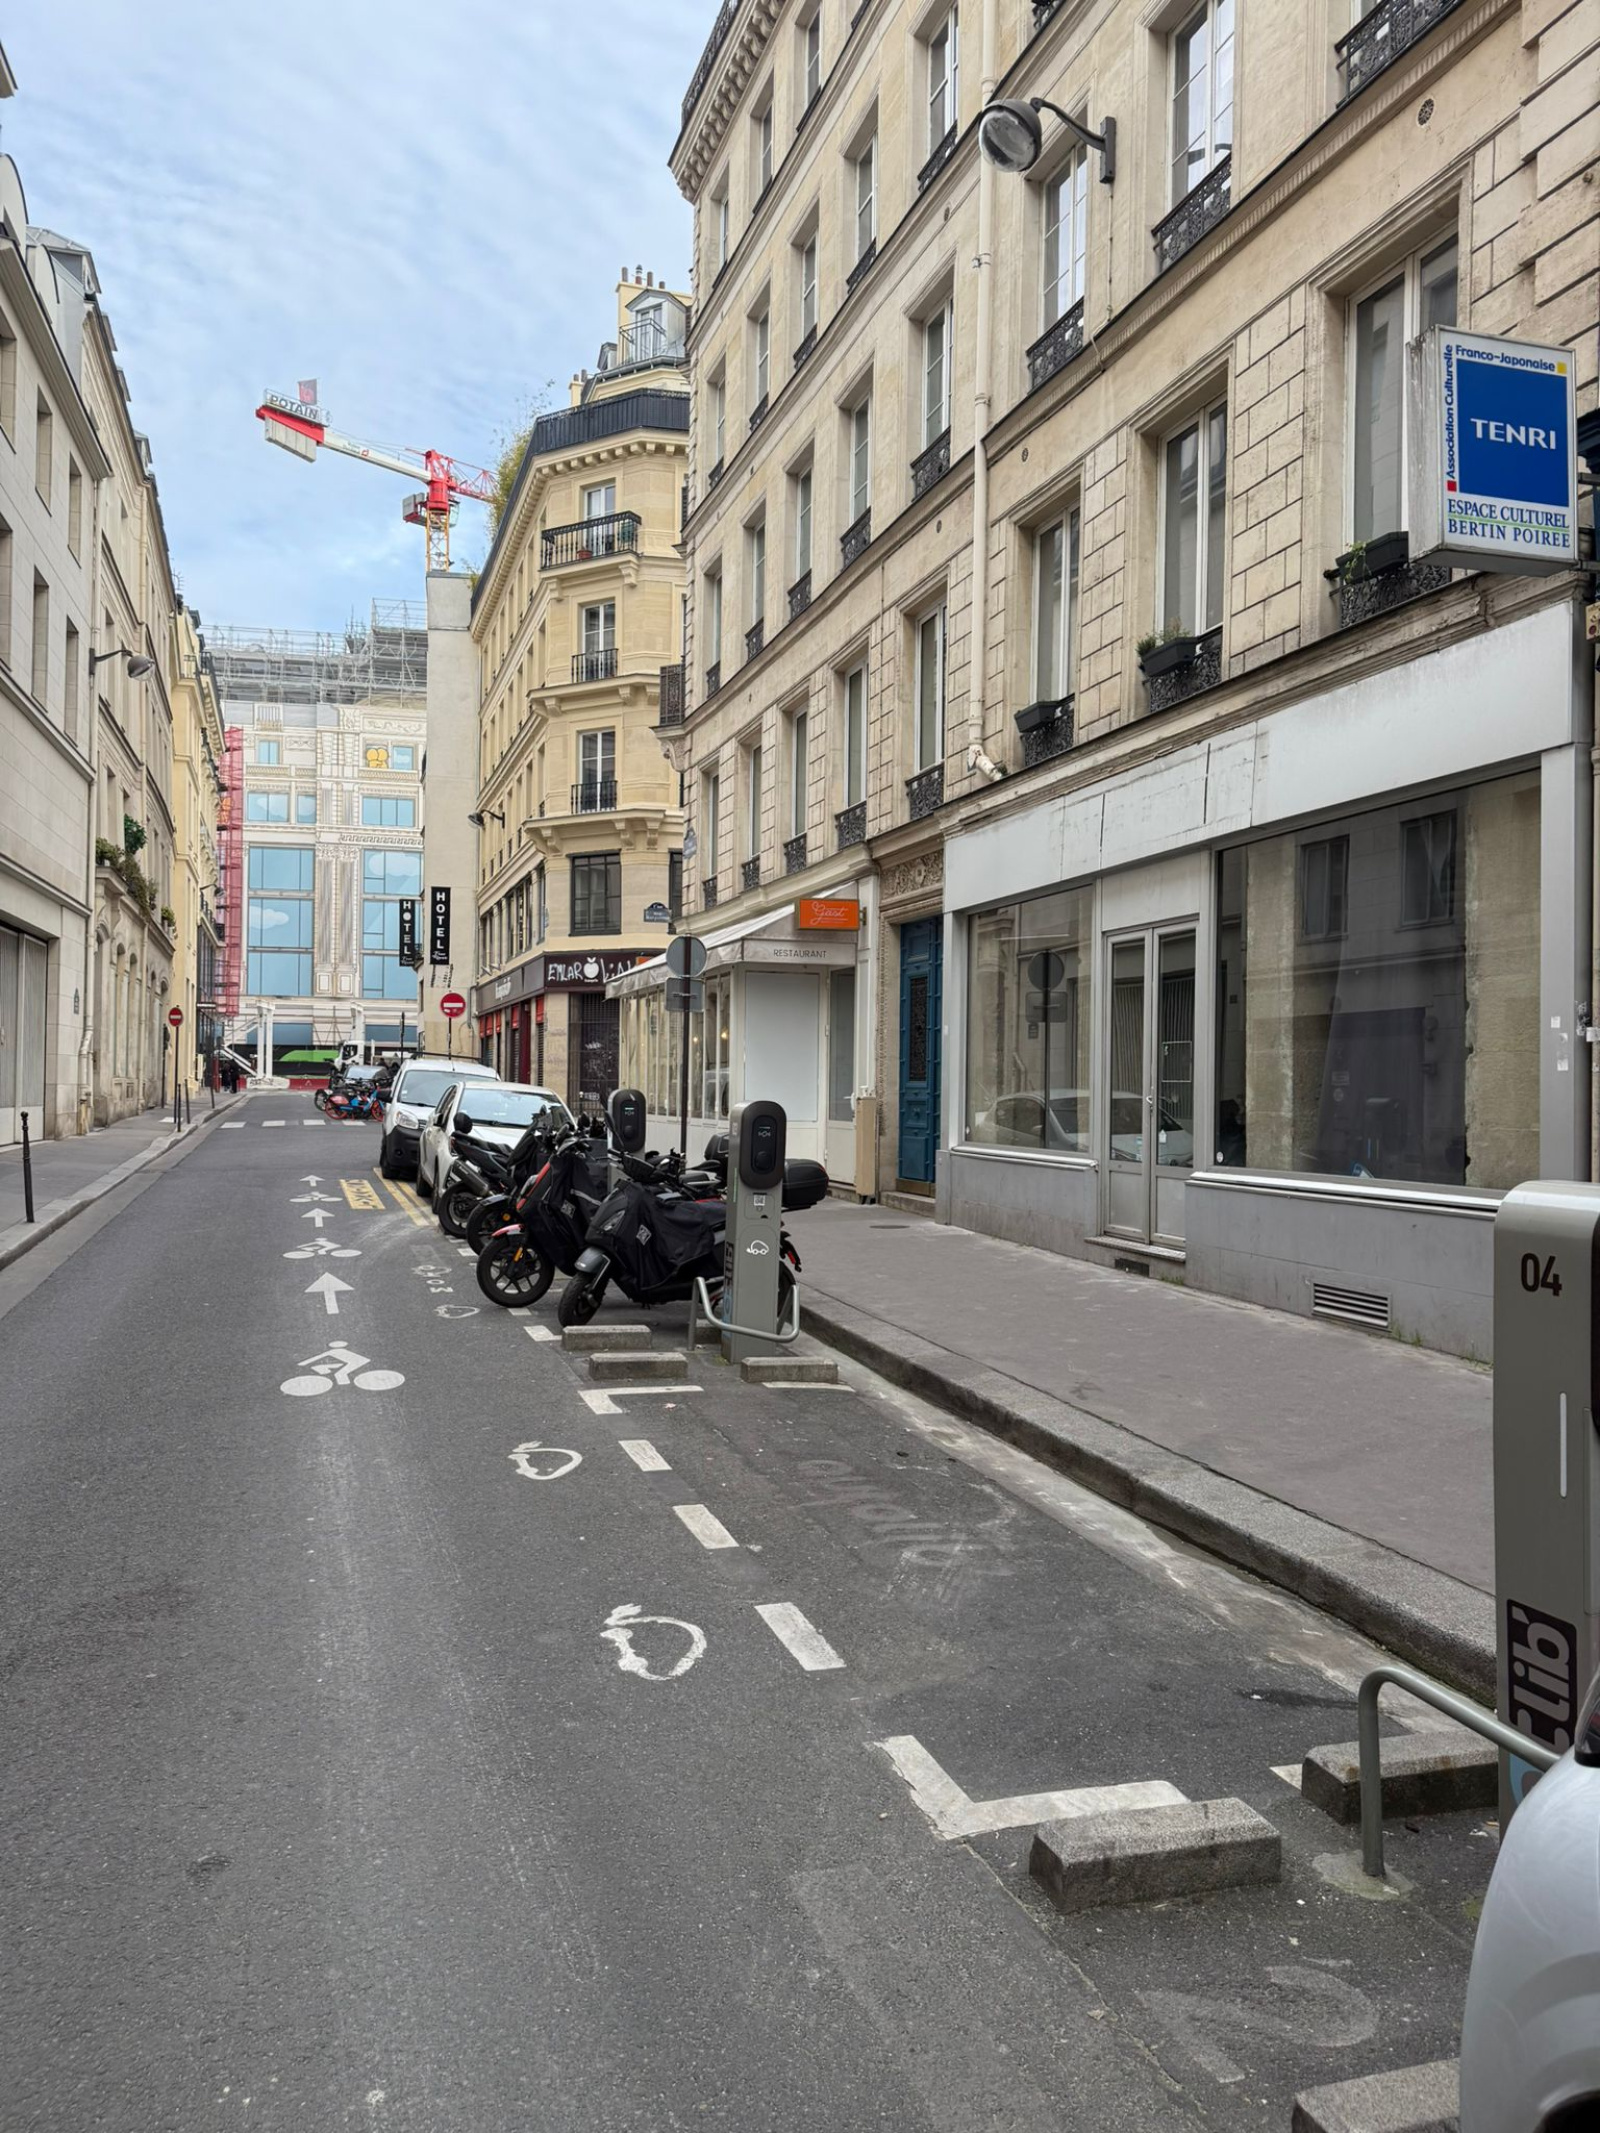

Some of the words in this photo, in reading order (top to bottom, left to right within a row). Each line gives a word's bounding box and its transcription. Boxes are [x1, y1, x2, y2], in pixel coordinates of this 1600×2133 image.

[1455, 344, 1556, 372] Franco-Japonaise
[1444, 344, 1454, 406] Culturelle
[269, 394, 318, 420] POTAIN
[1446, 407, 1456, 479] Association
[1470, 417, 1556, 450] TENRI
[1447, 498, 1498, 519] ESPACE
[1500, 505, 1570, 529] CULTUREL
[1448, 518, 1506, 541] BERTIN
[402, 900, 412, 955] HOTEL
[436, 891, 446, 949] HOTEL
[773, 948, 827, 959] RESTAURANT
[1520, 1252, 1562, 1297] 04
